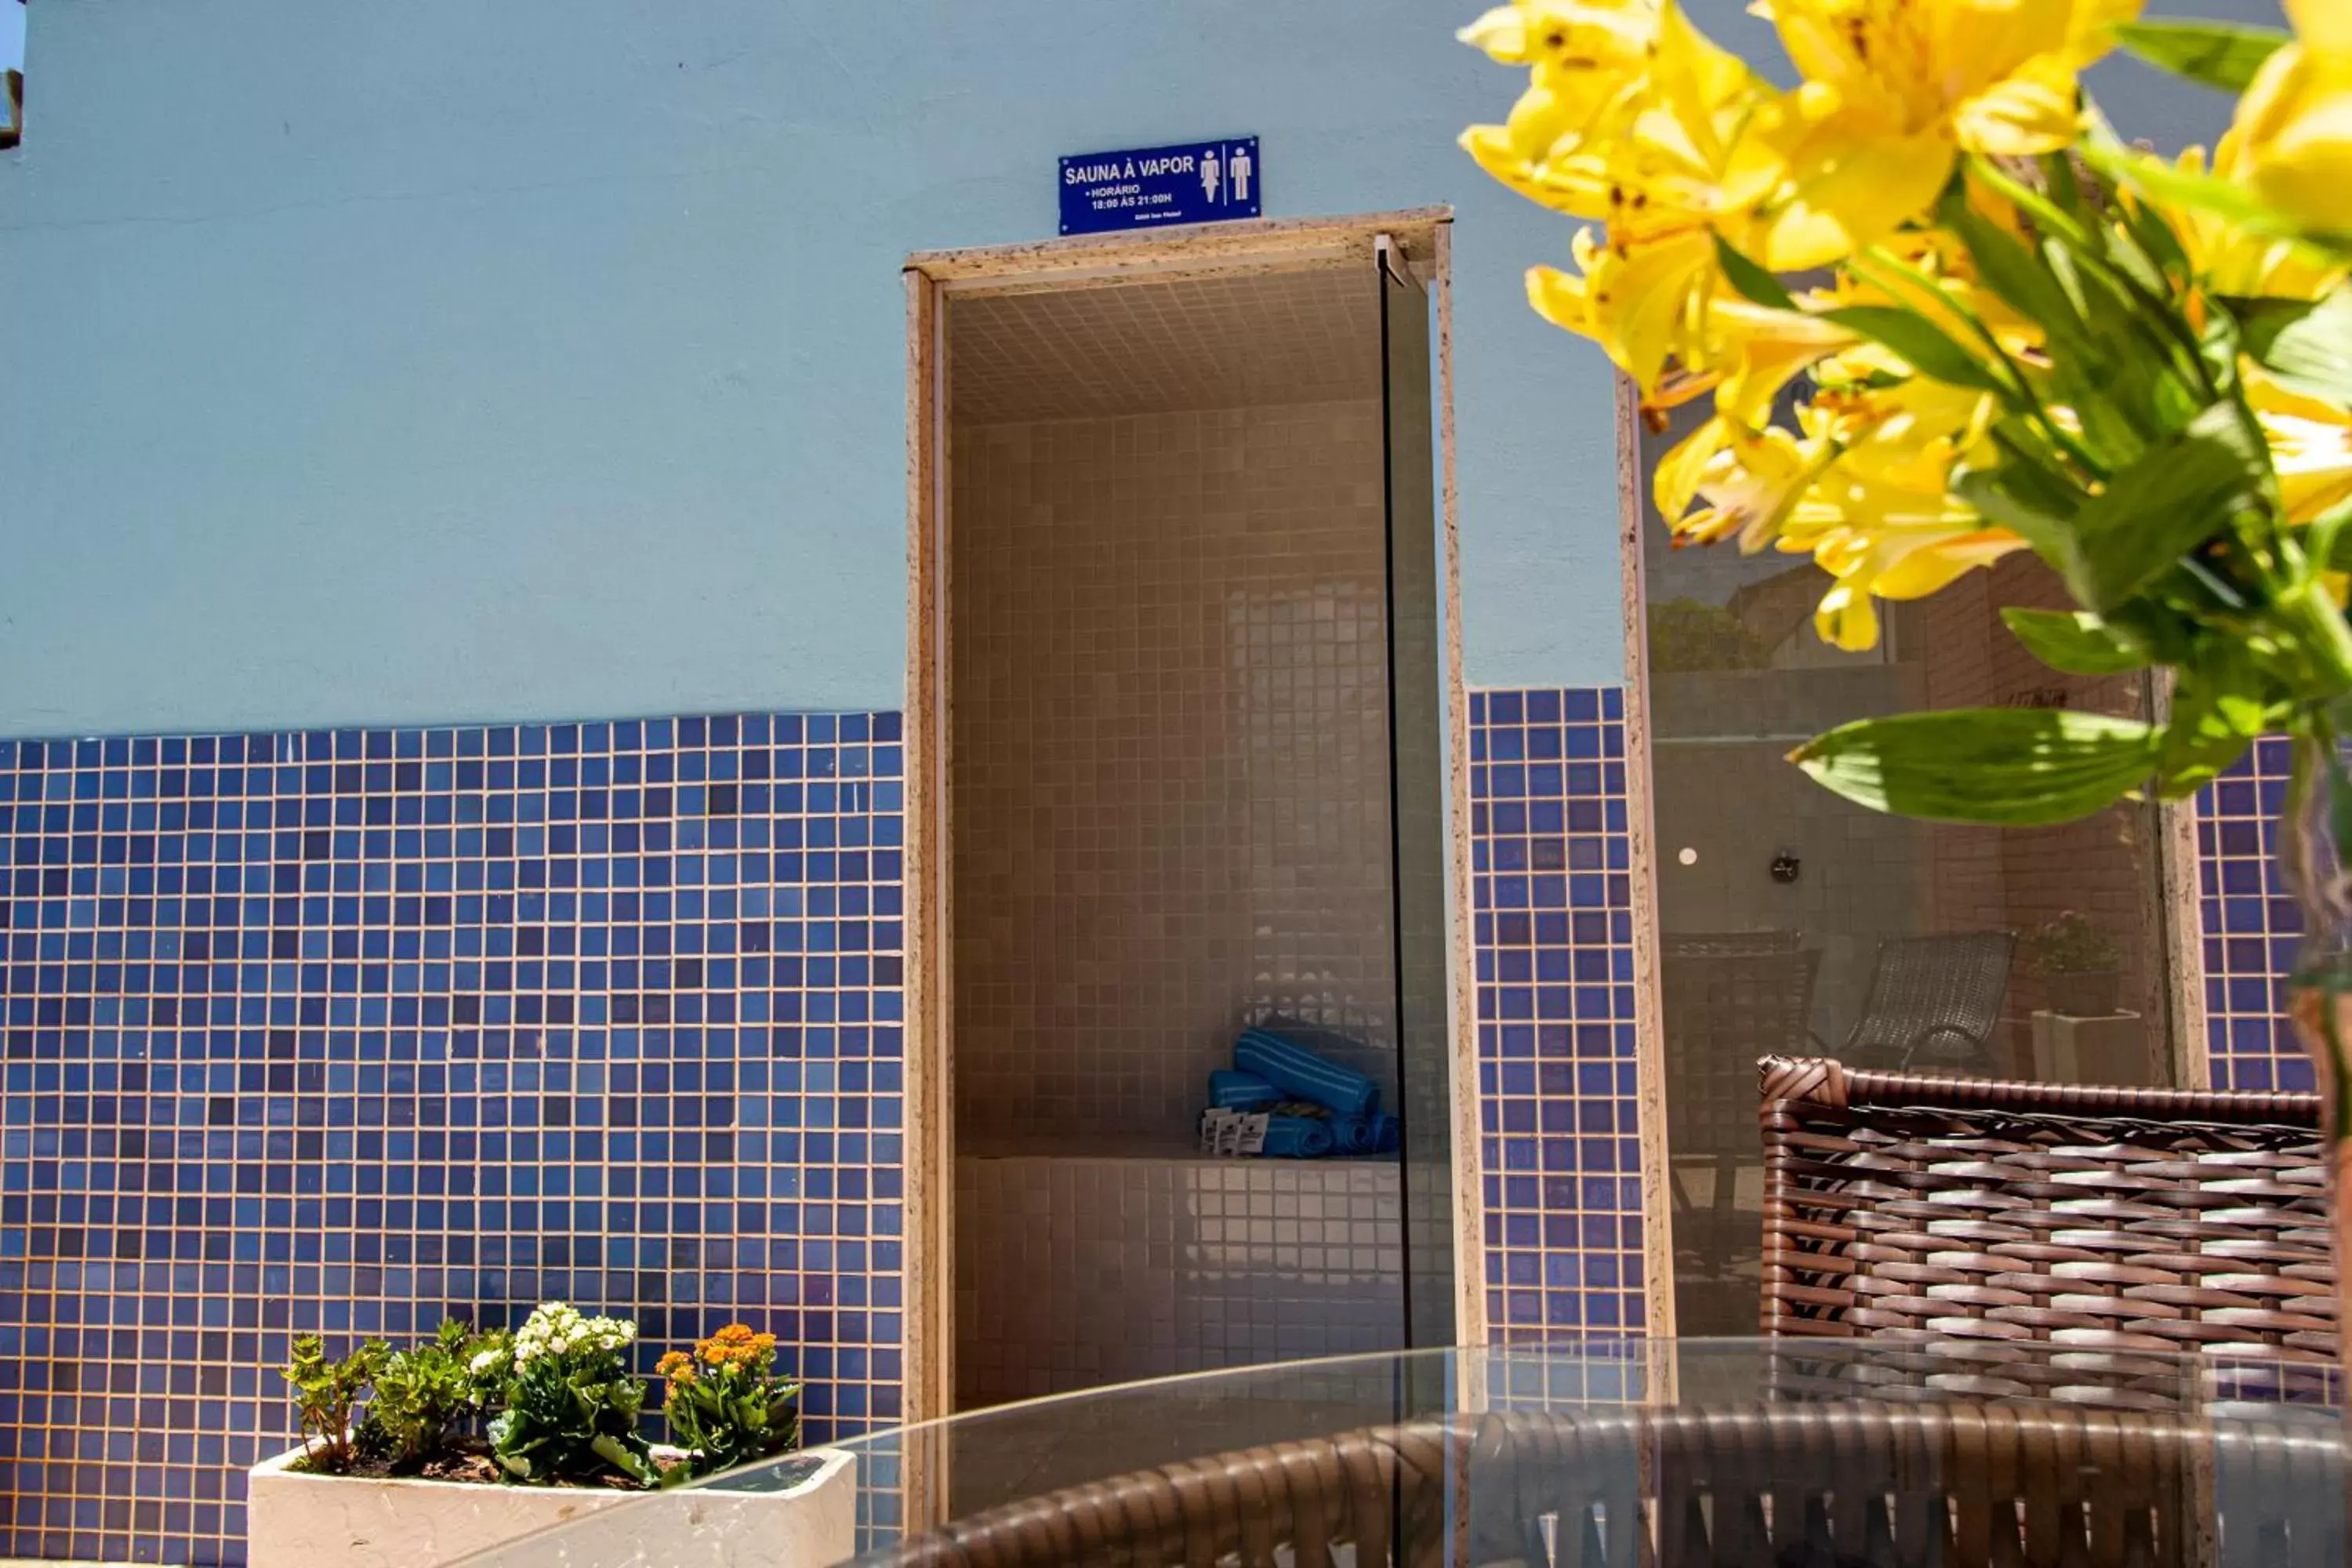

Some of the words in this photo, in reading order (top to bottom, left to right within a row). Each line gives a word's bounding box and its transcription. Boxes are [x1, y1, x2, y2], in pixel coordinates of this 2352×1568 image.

[1065, 163, 1120, 185] SAUNA
[1123, 157, 1136, 180] À
[1138, 155, 1195, 177] VAPOR
[1091, 183, 1140, 198] HORÁRIO
[1092, 199, 1119, 210] 18:00
[1137, 193, 1172, 205] 21:00H
